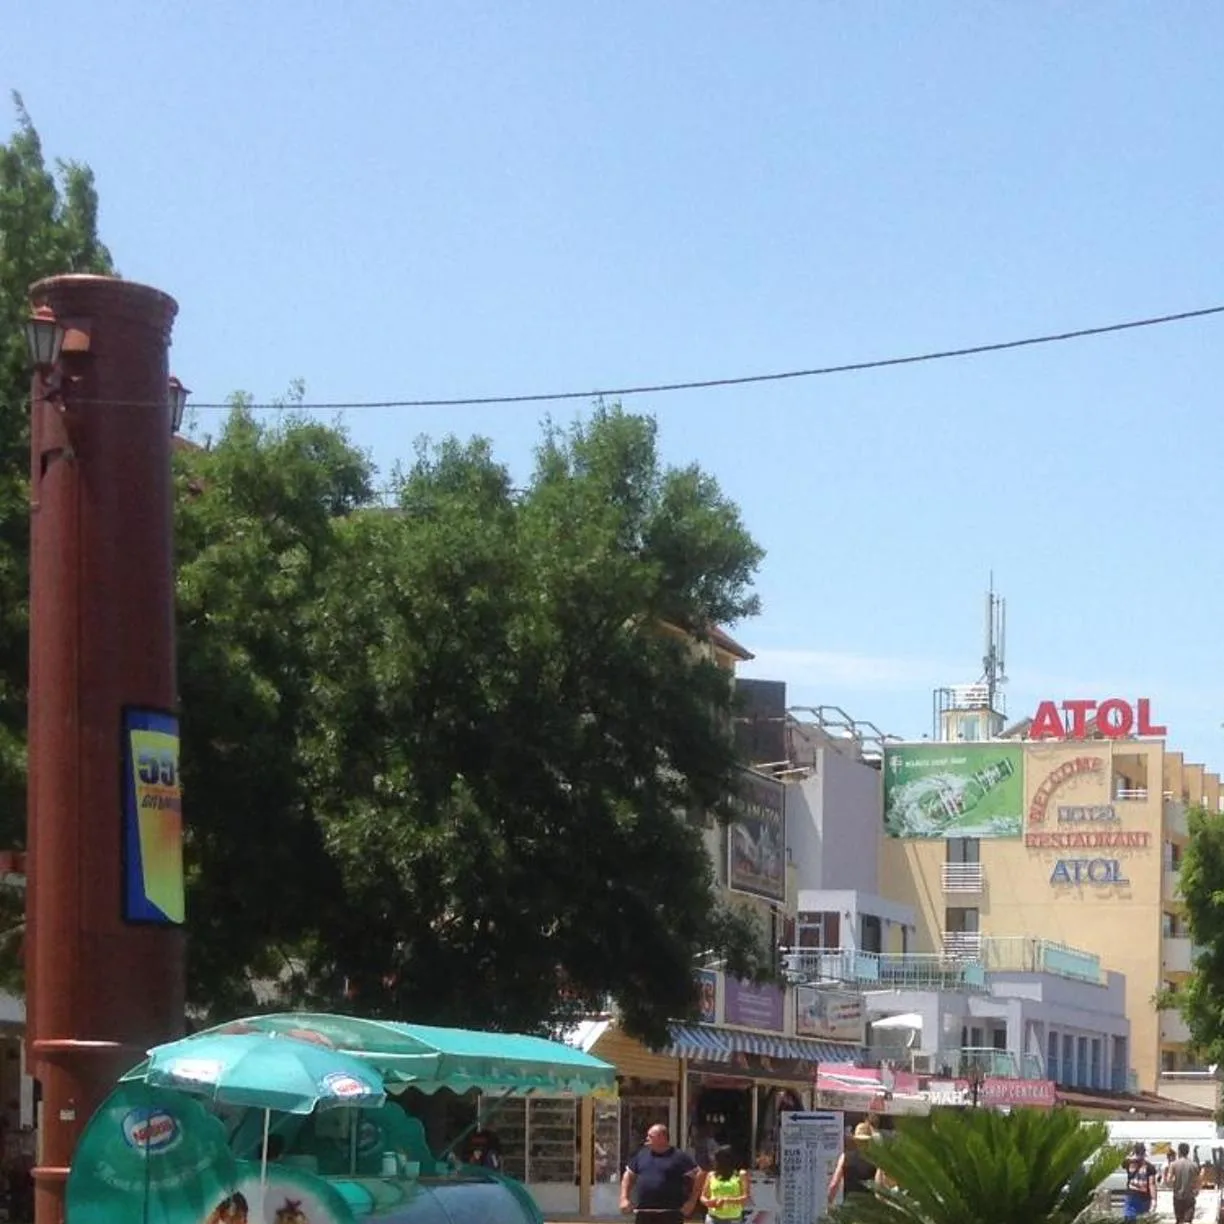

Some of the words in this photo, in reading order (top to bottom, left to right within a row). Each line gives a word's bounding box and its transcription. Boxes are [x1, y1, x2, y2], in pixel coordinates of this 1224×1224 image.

[1029, 698, 1167, 739] ATOL
[1027, 756, 1104, 824] WELCOME
[1024, 831, 1152, 849] RESTAURANT
[1049, 858, 1130, 885] ATOL
